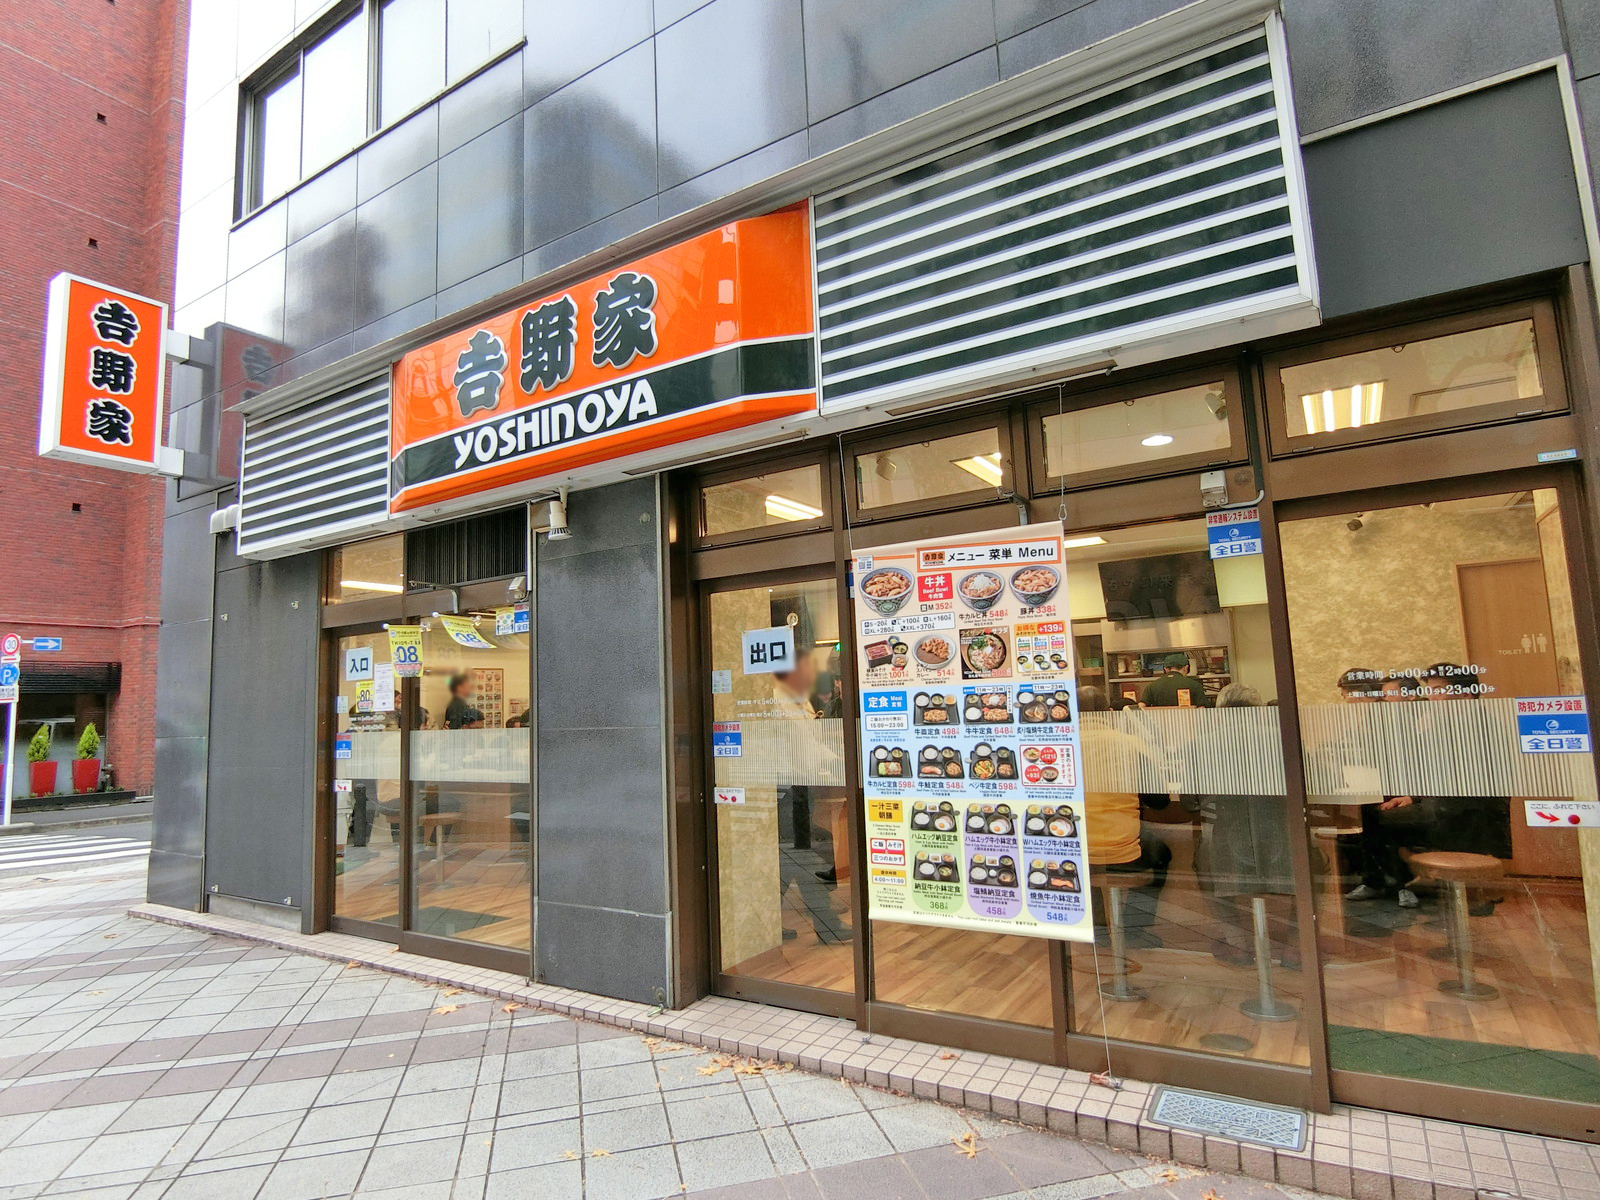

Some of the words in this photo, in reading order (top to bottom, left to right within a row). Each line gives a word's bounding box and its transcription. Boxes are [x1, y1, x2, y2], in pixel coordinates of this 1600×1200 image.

[453, 271, 658, 418] 吉野家
[84, 298, 141, 446] 吉野家
[454, 378, 658, 470] YOSHINOYA
[948, 552, 984, 562] メニュー
[1018, 547, 1054, 558] Menu
[924, 575, 946, 588] 牛丼
[935, 602, 948, 610] 352
[1036, 605, 1052, 614] 338
[989, 609, 1005, 617] 548
[6, 639, 17, 650] 30
[750, 641, 786, 664] 出口
[349, 657, 369, 673] 入口
[937, 669, 951, 677] 514
[1346, 670, 1384, 681] 営業時間
[868, 696, 889, 708] 定食
[1517, 700, 1583, 713] 防犯カメラ設置
[941, 727, 956, 735] 498
[993, 726, 1010, 734] 648
[1055, 725, 1070, 733] 748
[1527, 737, 1583, 750] 全日警
[867, 780, 897, 788] 牛カルビ定食
[946, 781, 961, 789] 548
[998, 782, 1015, 790] 598
[871, 802, 900, 811] 一汁三菜
[930, 901, 944, 910] 368
[986, 906, 1002, 916] 458
[1046, 911, 1064, 921] 548
